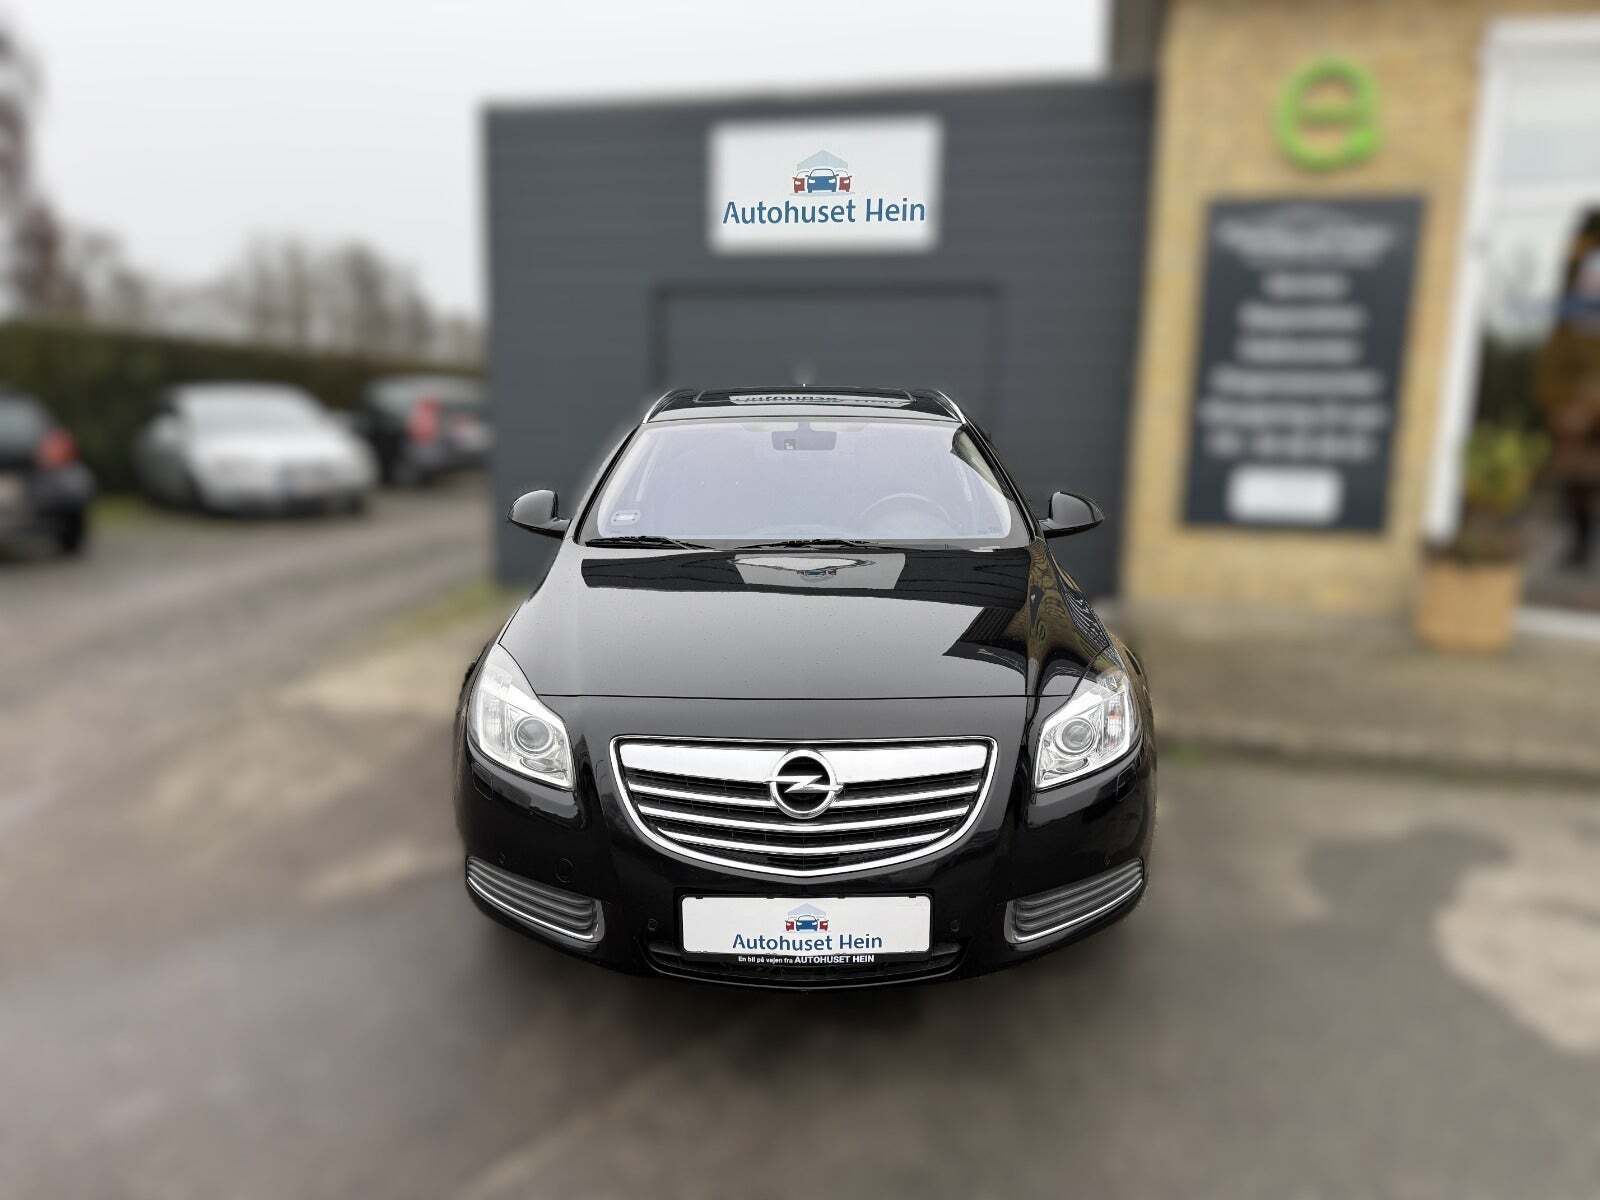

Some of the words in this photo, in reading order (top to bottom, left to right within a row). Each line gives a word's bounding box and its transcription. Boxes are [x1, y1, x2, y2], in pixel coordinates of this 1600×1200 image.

[722, 199, 856, 224] Autohuset
[865, 197, 926, 222] Hein
[732, 934, 832, 951] Autohuset
[840, 934, 883, 949] Hein
[794, 955, 851, 964] AUTOHUSET
[852, 955, 875, 963] HEIN
